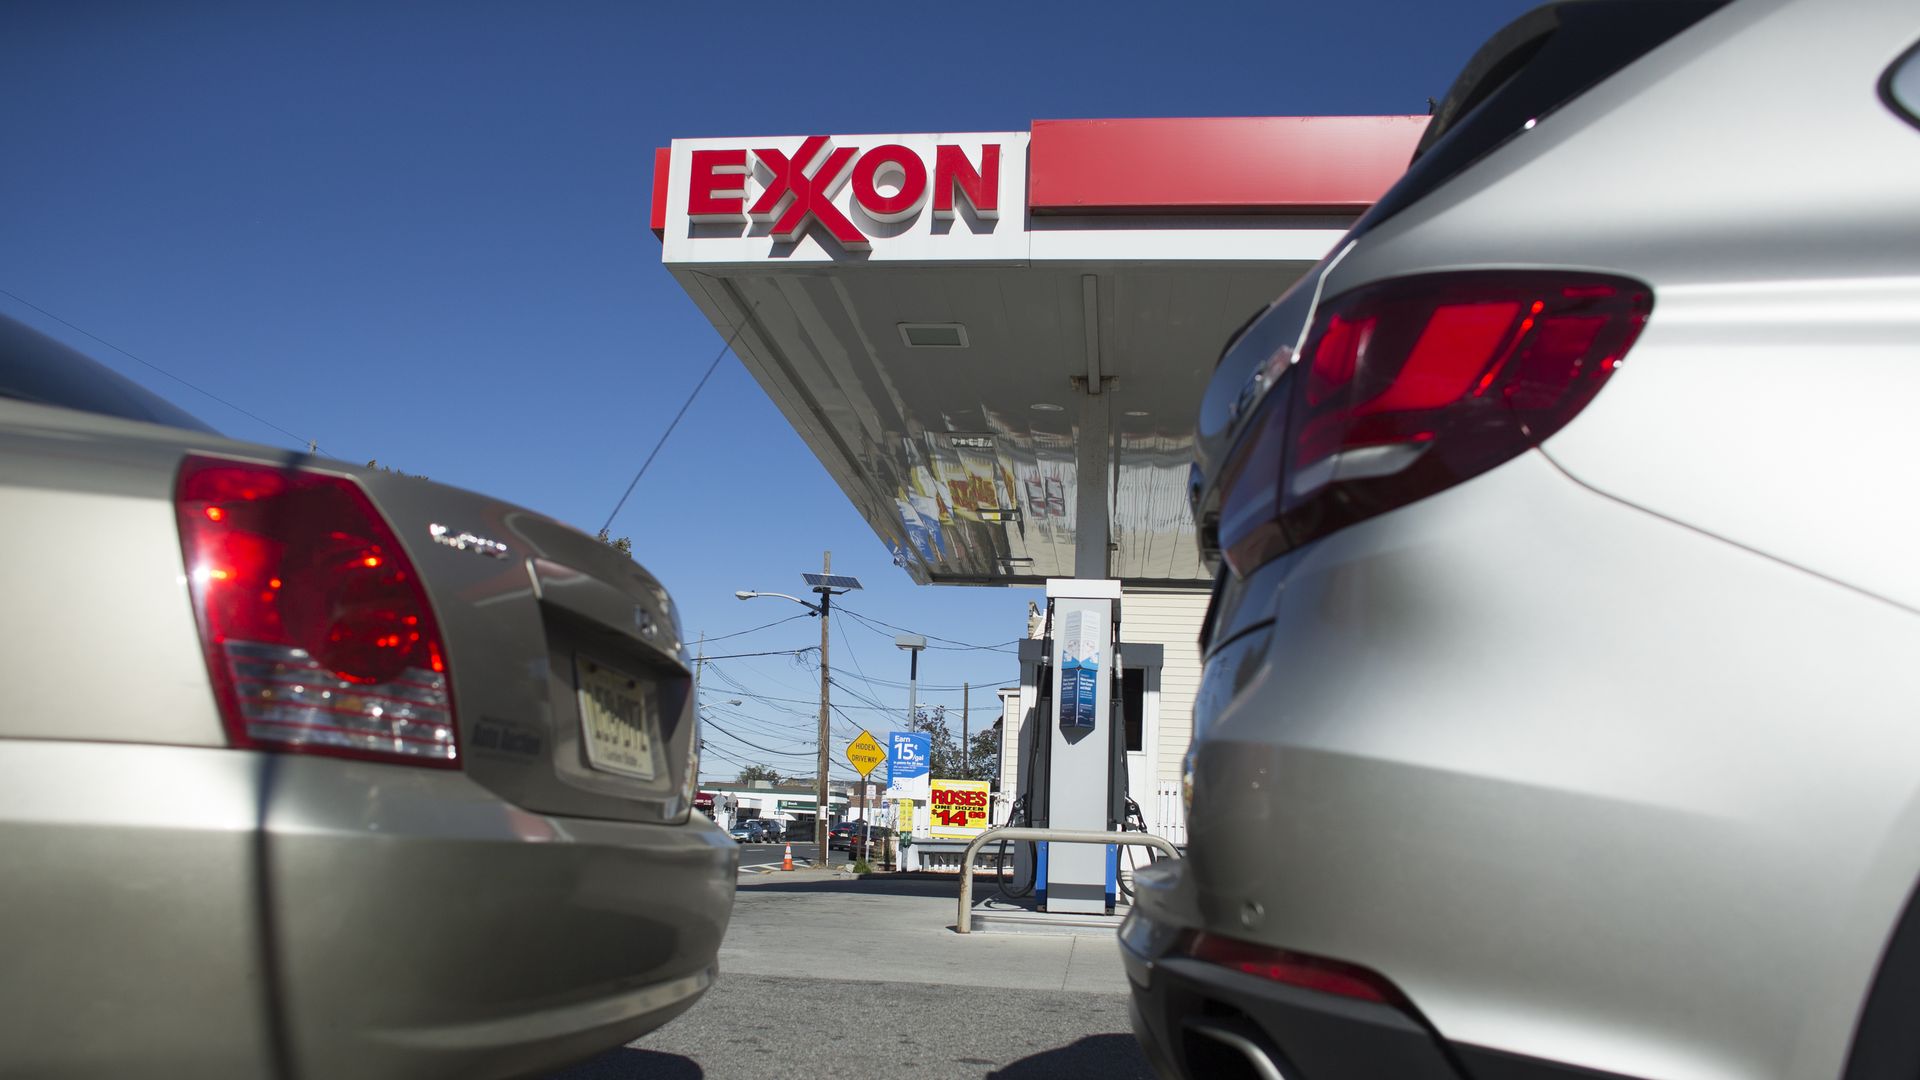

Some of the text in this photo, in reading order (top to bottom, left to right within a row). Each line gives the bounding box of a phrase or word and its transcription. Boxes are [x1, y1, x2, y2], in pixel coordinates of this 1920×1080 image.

[686, 135, 1001, 248] EXXON
[895, 735, 911, 743] Earn
[855, 743, 876, 751] HIDDEN
[852, 754, 878, 763] DRIVEWAY
[931, 789, 988, 807] ROSES
